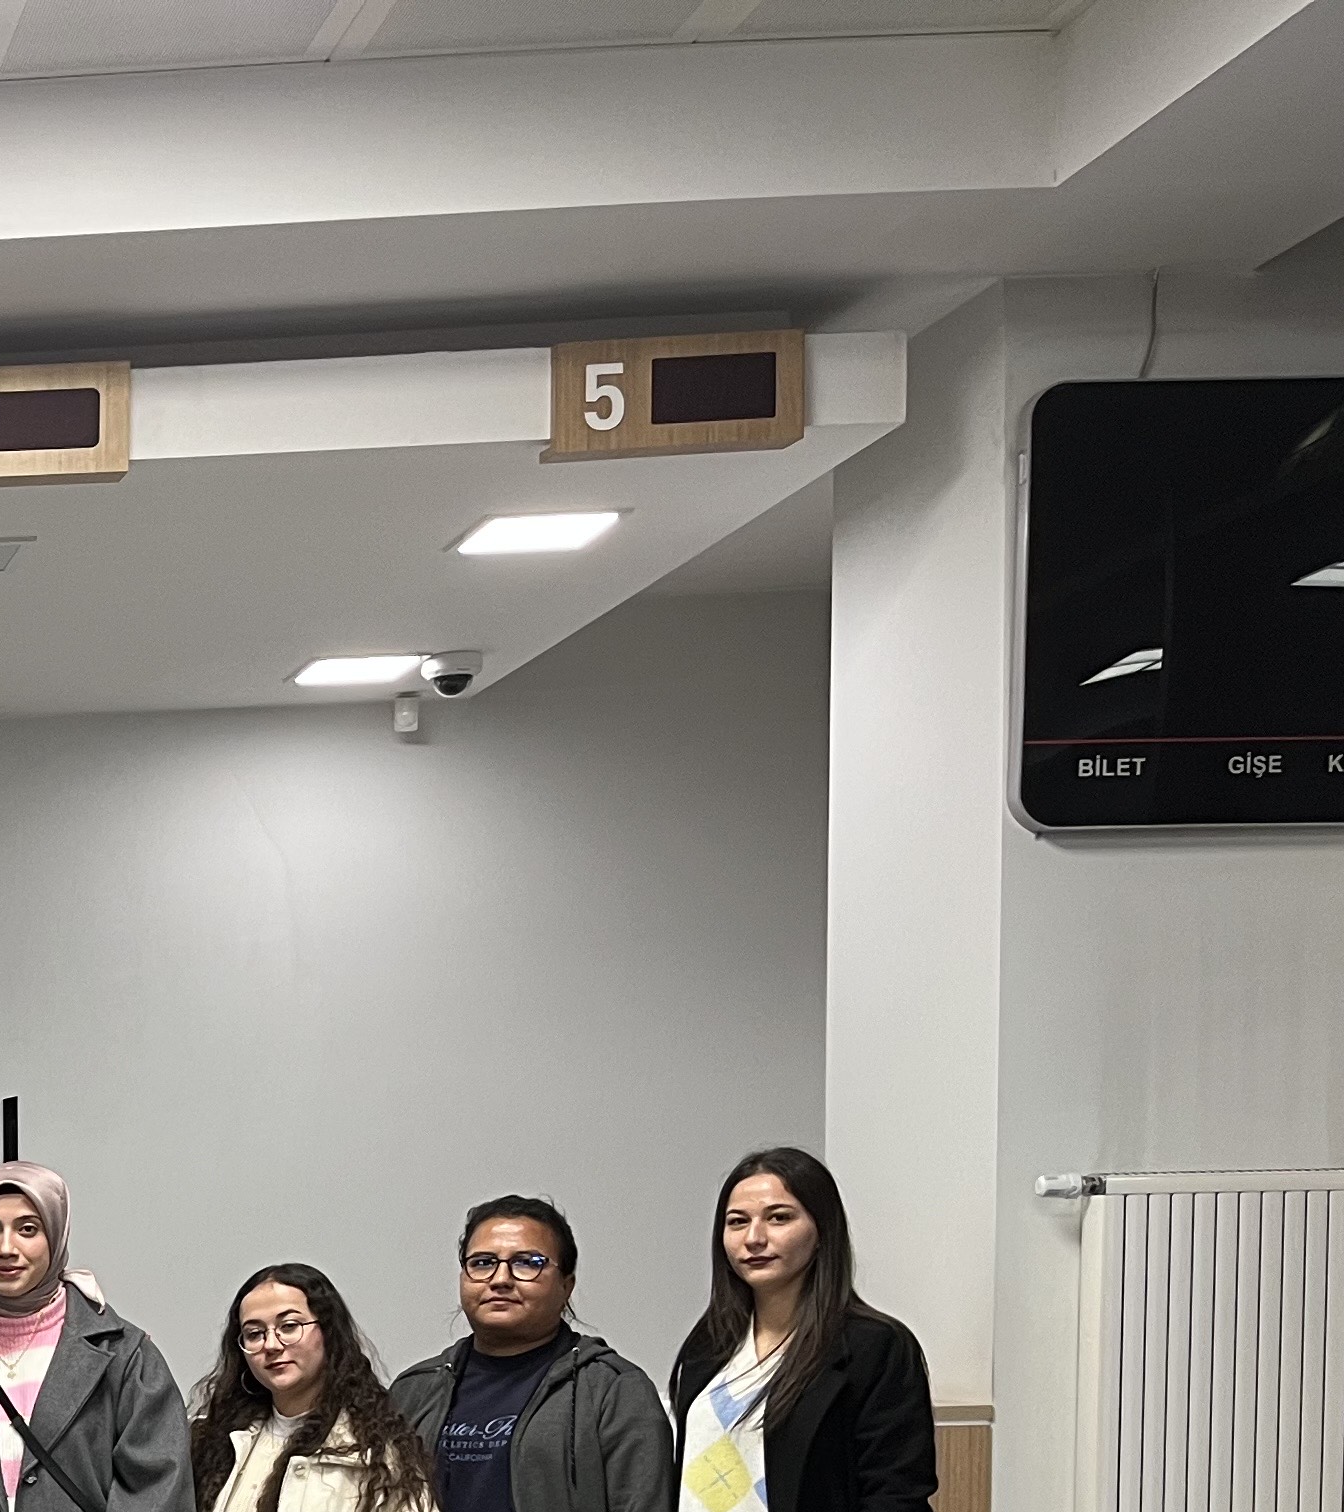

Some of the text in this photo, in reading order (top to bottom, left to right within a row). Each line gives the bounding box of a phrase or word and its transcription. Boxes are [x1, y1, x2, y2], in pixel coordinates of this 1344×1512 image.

[584, 362, 624, 431] 5
[1077, 754, 1146, 777] BİLET
[1227, 751, 1282, 779] GİŞE
